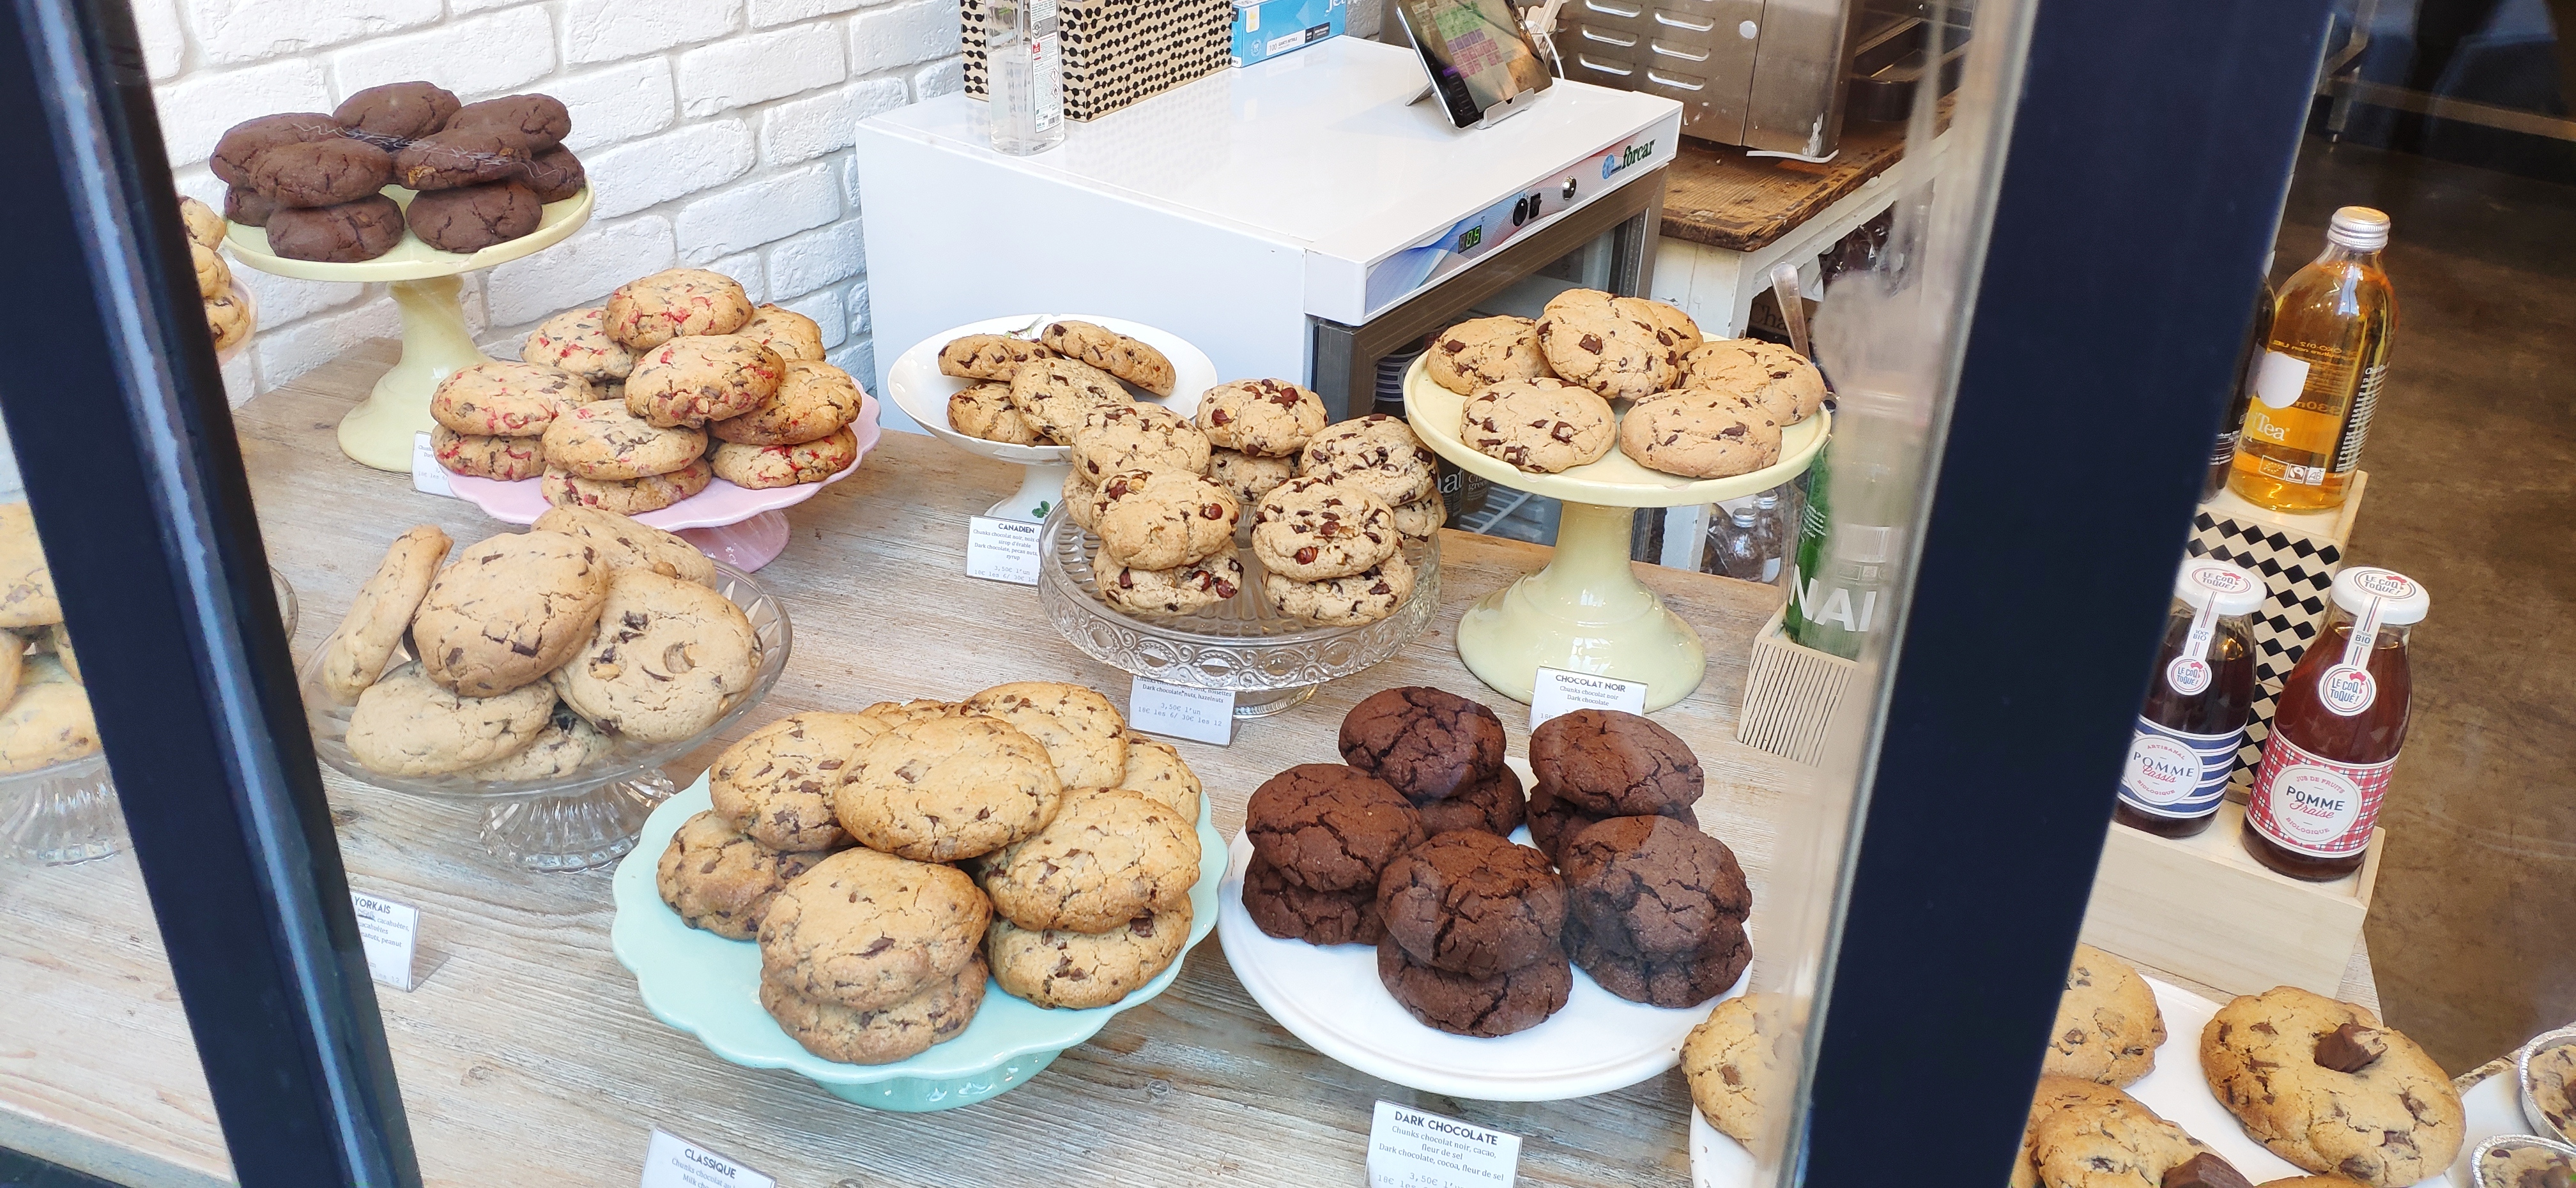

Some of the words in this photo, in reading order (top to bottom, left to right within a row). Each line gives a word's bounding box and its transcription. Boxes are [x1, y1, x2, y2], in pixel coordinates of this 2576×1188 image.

[1621, 139, 1655, 169] forcar
[998, 523, 1034, 533] CANADIEN
[986, 544, 1010, 552] chocolate,
[2215, 575, 2234, 584] COQ
[2379, 579, 2398, 589] COQ
[2193, 633, 2207, 641] BIO
[2355, 634, 2371, 644] BIO
[2186, 669, 2198, 678] COQ
[1556, 674, 1603, 689] CHOCOLAT
[1605, 682, 1626, 692] NOIR
[2332, 678, 2341, 689] LE
[2342, 681, 2359, 694] COQ
[1156, 687, 1183, 696] chocolate,
[1198, 694, 1223, 703] hazelnuts
[1560, 685, 1581, 694] Chunks
[1581, 689, 1606, 698] chocolat
[1161, 703, 1181, 712] 3,50€
[1185, 706, 1201, 715] l'un
[1582, 697, 1609, 706] chocolate
[2147, 744, 2185, 760] ARTISANAL
[2133, 751, 2195, 777] POMME
[2142, 765, 2176, 783] Cassis
[2137, 780, 2175, 795] BIOLOGIQUE
[2321, 779, 2345, 794] FRUITS
[2286, 785, 2345, 811] POMME
[2289, 800, 2335, 819] Fraise
[2286, 817, 2330, 835] BIOLOGIQUE
[355, 895, 391, 914] YORKAIS
[377, 918, 410, 932] cacahuètes,
[381, 937, 403, 948] peanut
[1395, 1110, 1425, 1128] DARK
[1428, 1120, 1498, 1145] CHOCOLATE
[1392, 1125, 1420, 1138] Chunks
[1420, 1133, 1453, 1147] chocolat
[1454, 1142, 1471, 1153] noir,
[1473, 1147, 1496, 1159] cacao,
[1422, 1143, 1440, 1154] fleur
[1441, 1148, 1451, 1157] de
[685, 1148, 737, 1179] CLASSIQUE
[1379, 1143, 1397, 1154] Dark
[1398, 1148, 1436, 1164] chocolate,
[1437, 1159, 1460, 1171] cocoa,
[1462, 1164, 1481, 1175] fleur
[1482, 1169, 1492, 1178] de
[671, 1158, 695, 1173] Chunks
[696, 1170, 723, 1187] chocolat
[682, 1173, 697, 1186] Milk
[1378, 1174, 1394, 1185] 18€
[1409, 1172, 1438, 1186] 3,50€
